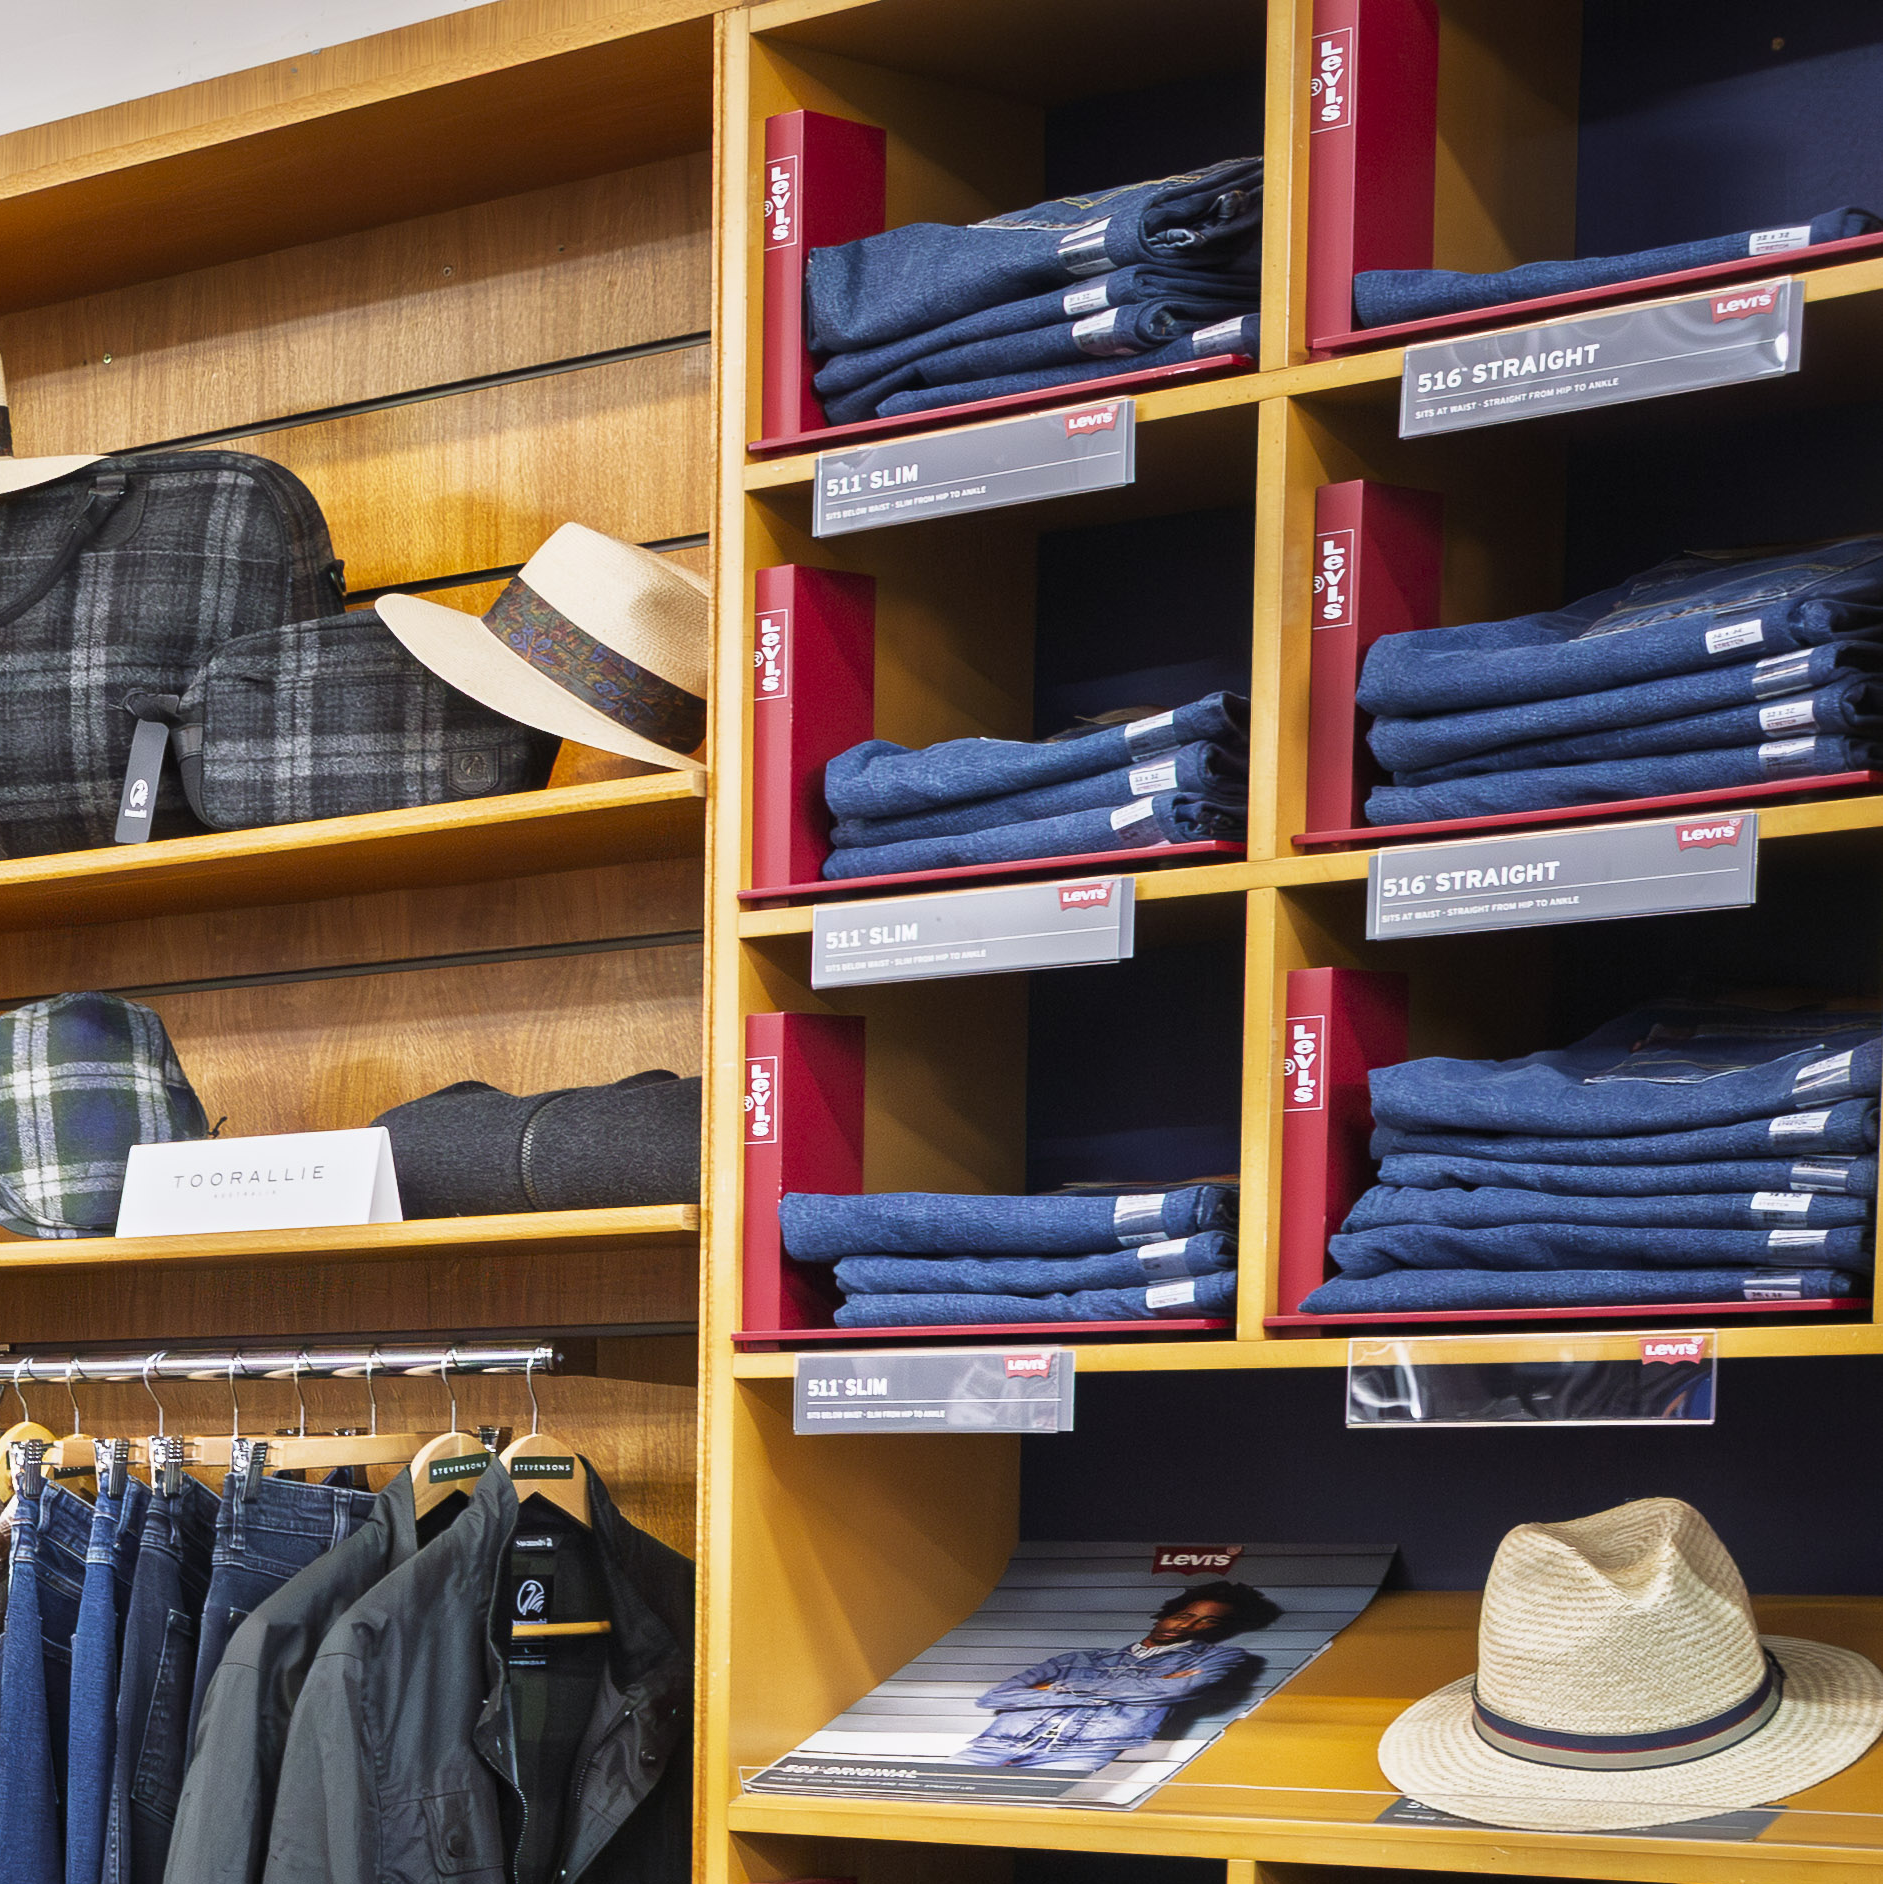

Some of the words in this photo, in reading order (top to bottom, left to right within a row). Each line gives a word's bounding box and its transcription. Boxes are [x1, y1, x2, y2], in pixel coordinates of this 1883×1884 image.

[1472, 344, 1599, 383] STRAIGHT
[1415, 408, 1434, 419] SITS
[1436, 406, 1447, 415] AT
[1449, 401, 1477, 413] WAIST
[1483, 393, 1526, 407] STRAIGHT
[1529, 388, 1553, 400] FROM
[1555, 385, 1571, 395] HIP
[1573, 382, 1586, 392] TO
[1588, 377, 1619, 390] ANKLE
[869, 464, 919, 489] SLIM
[825, 510, 841, 521] SITS
[895, 497, 913, 508] SLIM
[949, 489, 960, 499] TO
[1435, 861, 1560, 892] STRAIGHT
[1381, 913, 1400, 923] SITS
[1401, 912, 1413, 921] AT
[1414, 909, 1440, 920] WAIST
[1447, 904, 1489, 916] STRAIGHT
[1491, 901, 1515, 912] FROM
[1517, 900, 1533, 909] HIP
[1535, 898, 1547, 908] TO
[1549, 895, 1579, 906] ANKLE
[869, 923, 918, 946] SLIM
[173, 1165, 325, 1189] TOORALLIE
[845, 1378, 888, 1397] SLIM
[432, 1461, 488, 1477] STEVENSONS
[513, 1464, 571, 1472] STEVENSONS
